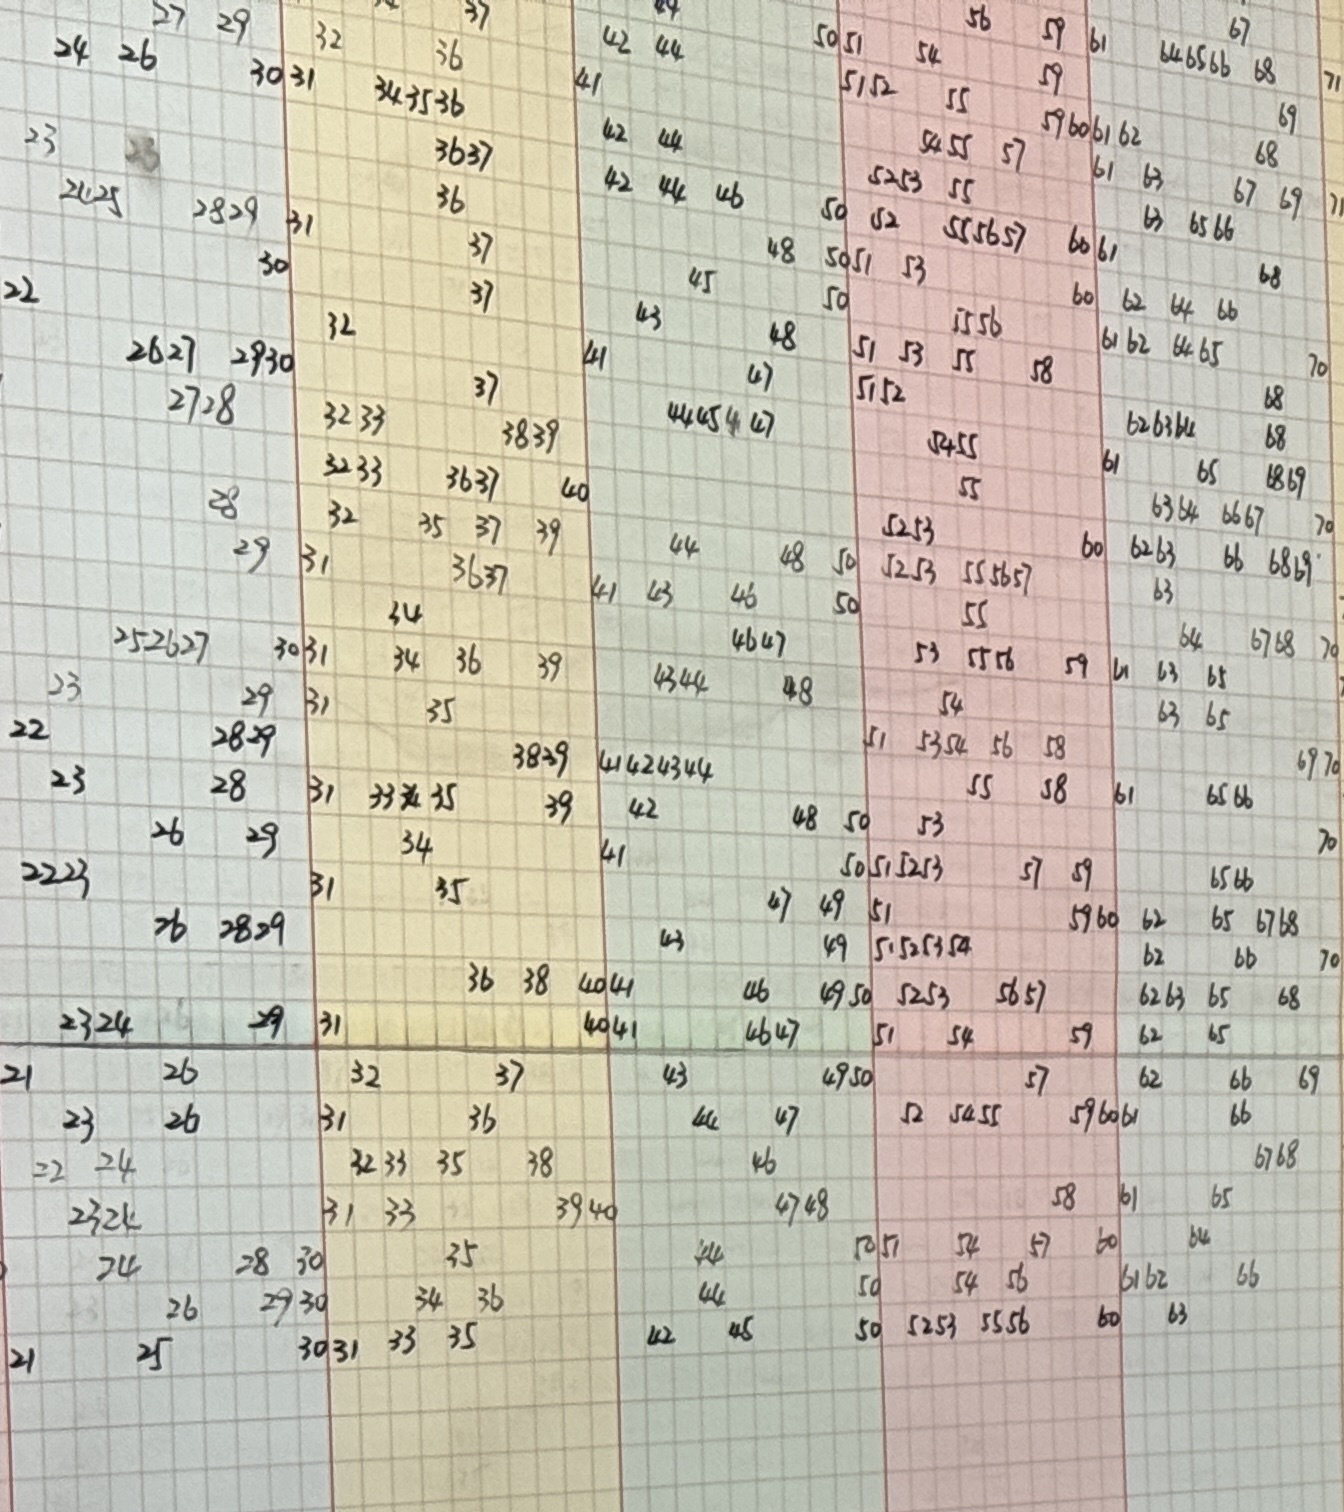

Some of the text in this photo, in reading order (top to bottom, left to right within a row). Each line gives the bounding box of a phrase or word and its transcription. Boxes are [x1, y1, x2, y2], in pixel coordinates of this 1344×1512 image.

[216, 7, 251, 47] 29
[315, 20, 342, 51] 32
[602, 24, 632, 55] 42
[1228, 16, 1251, 47] 67
[53, 34, 91, 67] 24
[117, 37, 158, 72] 26
[654, 33, 685, 62] 44
[915, 40, 943, 66] 54
[1038, 61, 1064, 97] 59
[945, 86, 971, 114] 55
[1278, 102, 1298, 136] 69
[1001, 137, 1026, 175] 57
[1254, 139, 1279, 169] 68
[1142, 162, 1165, 192] 63
[436, 183, 466, 215] 36
[715, 180, 745, 210] 46
[467, 231, 494, 265] 37
[3, 274, 41, 304] 22
[688, 266, 718, 295] 45
[635, 300, 662, 332] 43
[1217, 297, 1239, 322] 66
[327, 311, 357, 341] 32
[746, 360, 774, 393] 47
[1029, 355, 1054, 385] 58
[1196, 457, 1220, 486] 65
[327, 499, 360, 529] 32
[418, 511, 446, 539] 35
[1223, 541, 1245, 573] 66
[730, 581, 758, 610] 46
[961, 598, 989, 630] 55
[1179, 622, 1203, 652] 64
[455, 642, 482, 676] 36
[537, 651, 563, 683] 39
[938, 690, 964, 717] 54
[8, 718, 51, 741] 22
[1043, 734, 1066, 761] 58
[50, 764, 86, 796] 23
[209, 768, 247, 803] 28
[149, 815, 185, 847] 26
[245, 821, 280, 860] 29
[1211, 904, 1235, 933] 65
[1233, 945, 1258, 970] 66
[467, 961, 495, 993] 36
[162, 1056, 199, 1086] 26
[350, 1058, 382, 1089] 32
[494, 1058, 525, 1094] 37
[662, 1061, 688, 1090] 43
[1024, 1064, 1050, 1097] 57
[1138, 1065, 1163, 1090] 62
[62, 1105, 95, 1145] 23
[774, 1105, 800, 1137] 47
[94, 1147, 137, 1182] 24
[751, 1145, 777, 1176] 46
[234, 1246, 270, 1277] 28
[727, 1314, 754, 1342] 45
[1167, 1301, 1188, 1326] 63
[447, 1321, 479, 1350] 35
